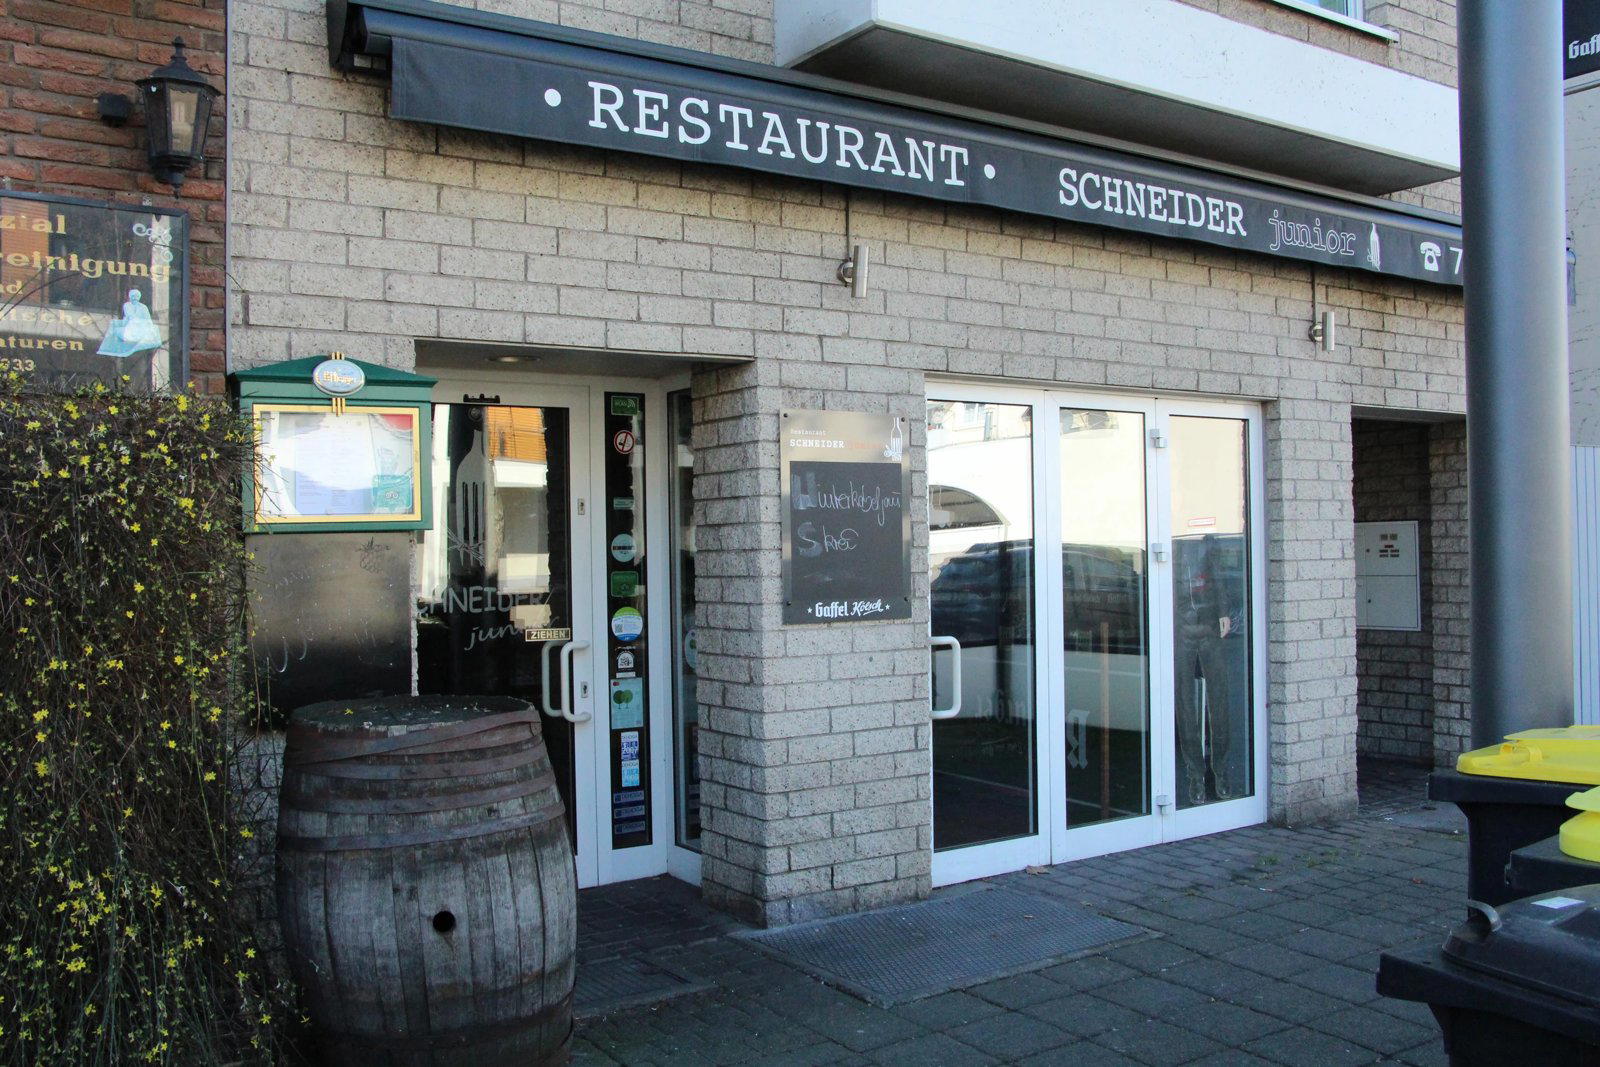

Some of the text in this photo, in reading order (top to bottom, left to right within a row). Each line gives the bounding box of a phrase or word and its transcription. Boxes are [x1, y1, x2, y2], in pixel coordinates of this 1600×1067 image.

[588, 81, 968, 186] RESTAURANT
[1059, 167, 1247, 237] SCHNEIDER
[1269, 209, 1356, 256] junior
[0, 250, 171, 283] einigung
[789, 439, 845, 449] SCHNEIDER
[815, 598, 885, 619] Gaffel Kölsch
[530, 630, 567, 640] ZIEHEN
